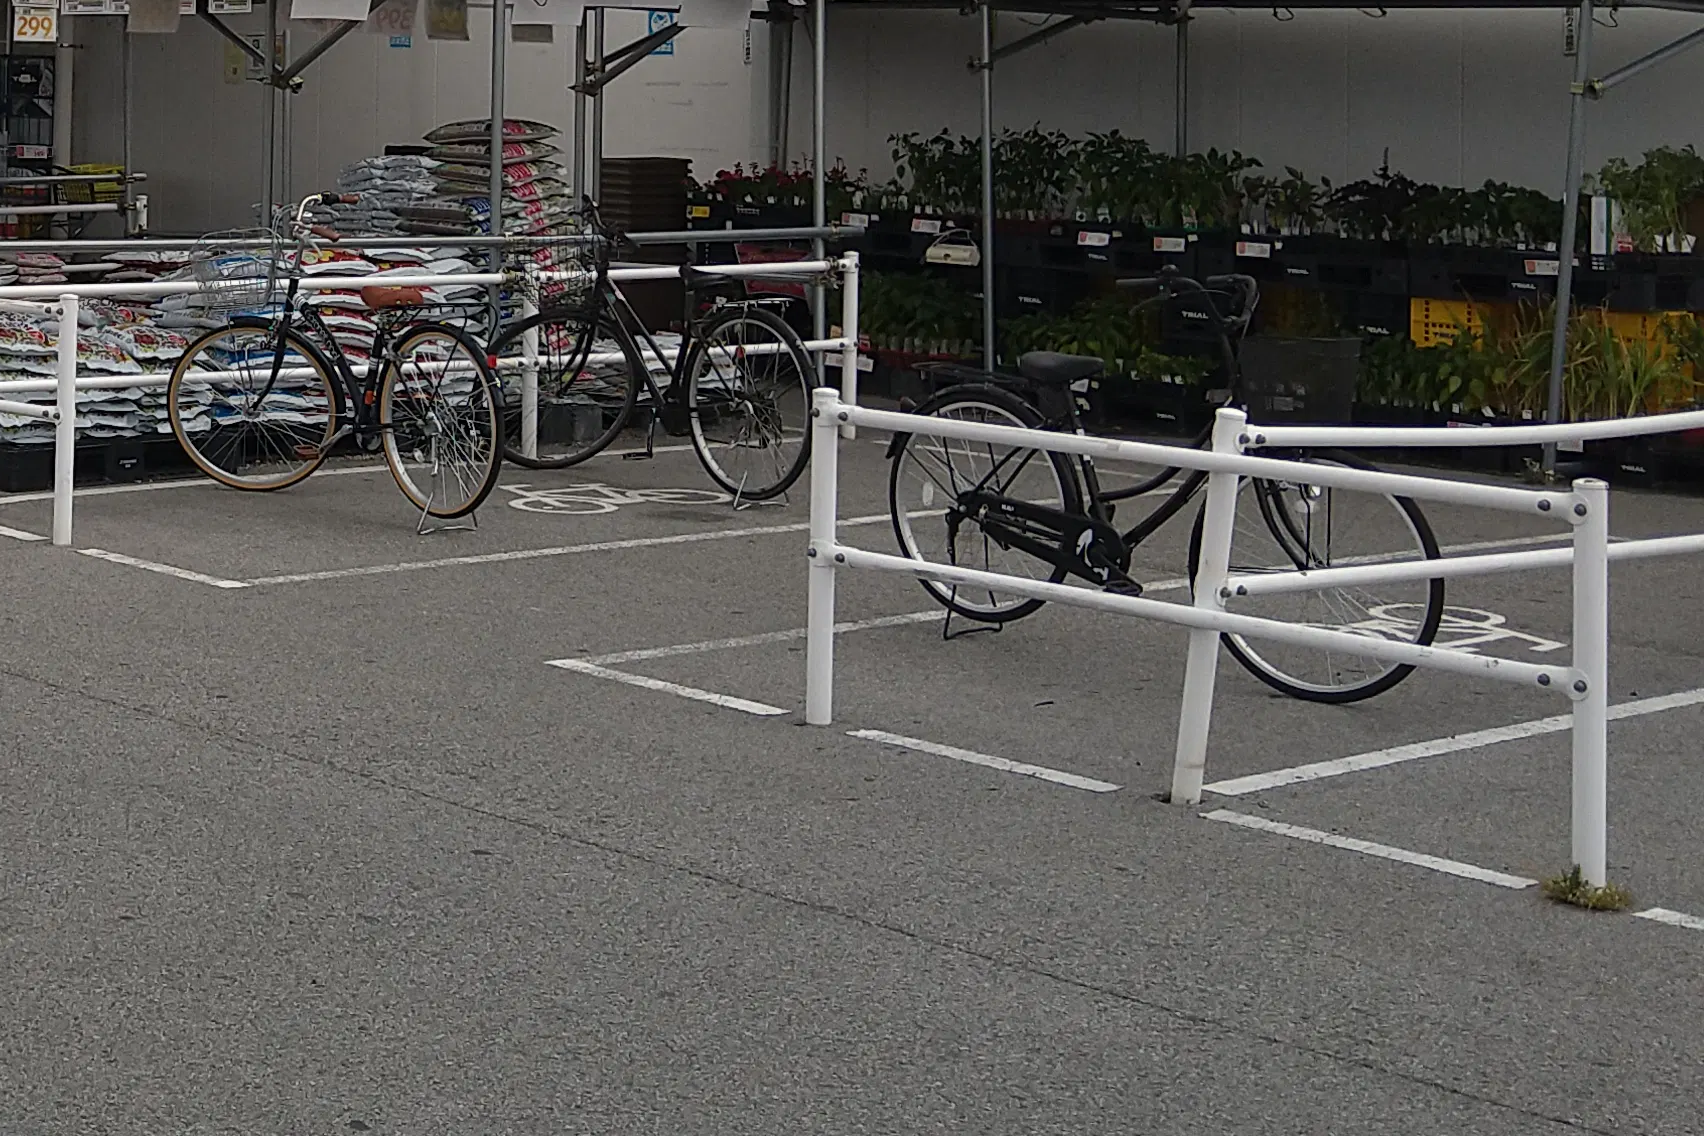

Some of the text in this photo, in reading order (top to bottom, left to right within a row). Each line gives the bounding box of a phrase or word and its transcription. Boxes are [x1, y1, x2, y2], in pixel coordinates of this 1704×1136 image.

[17, 16, 52, 37] 299
[1017, 296, 1041, 304] TRIAL
[1180, 310, 1207, 319] TRIAL
[1359, 325, 1390, 335] TIAL
